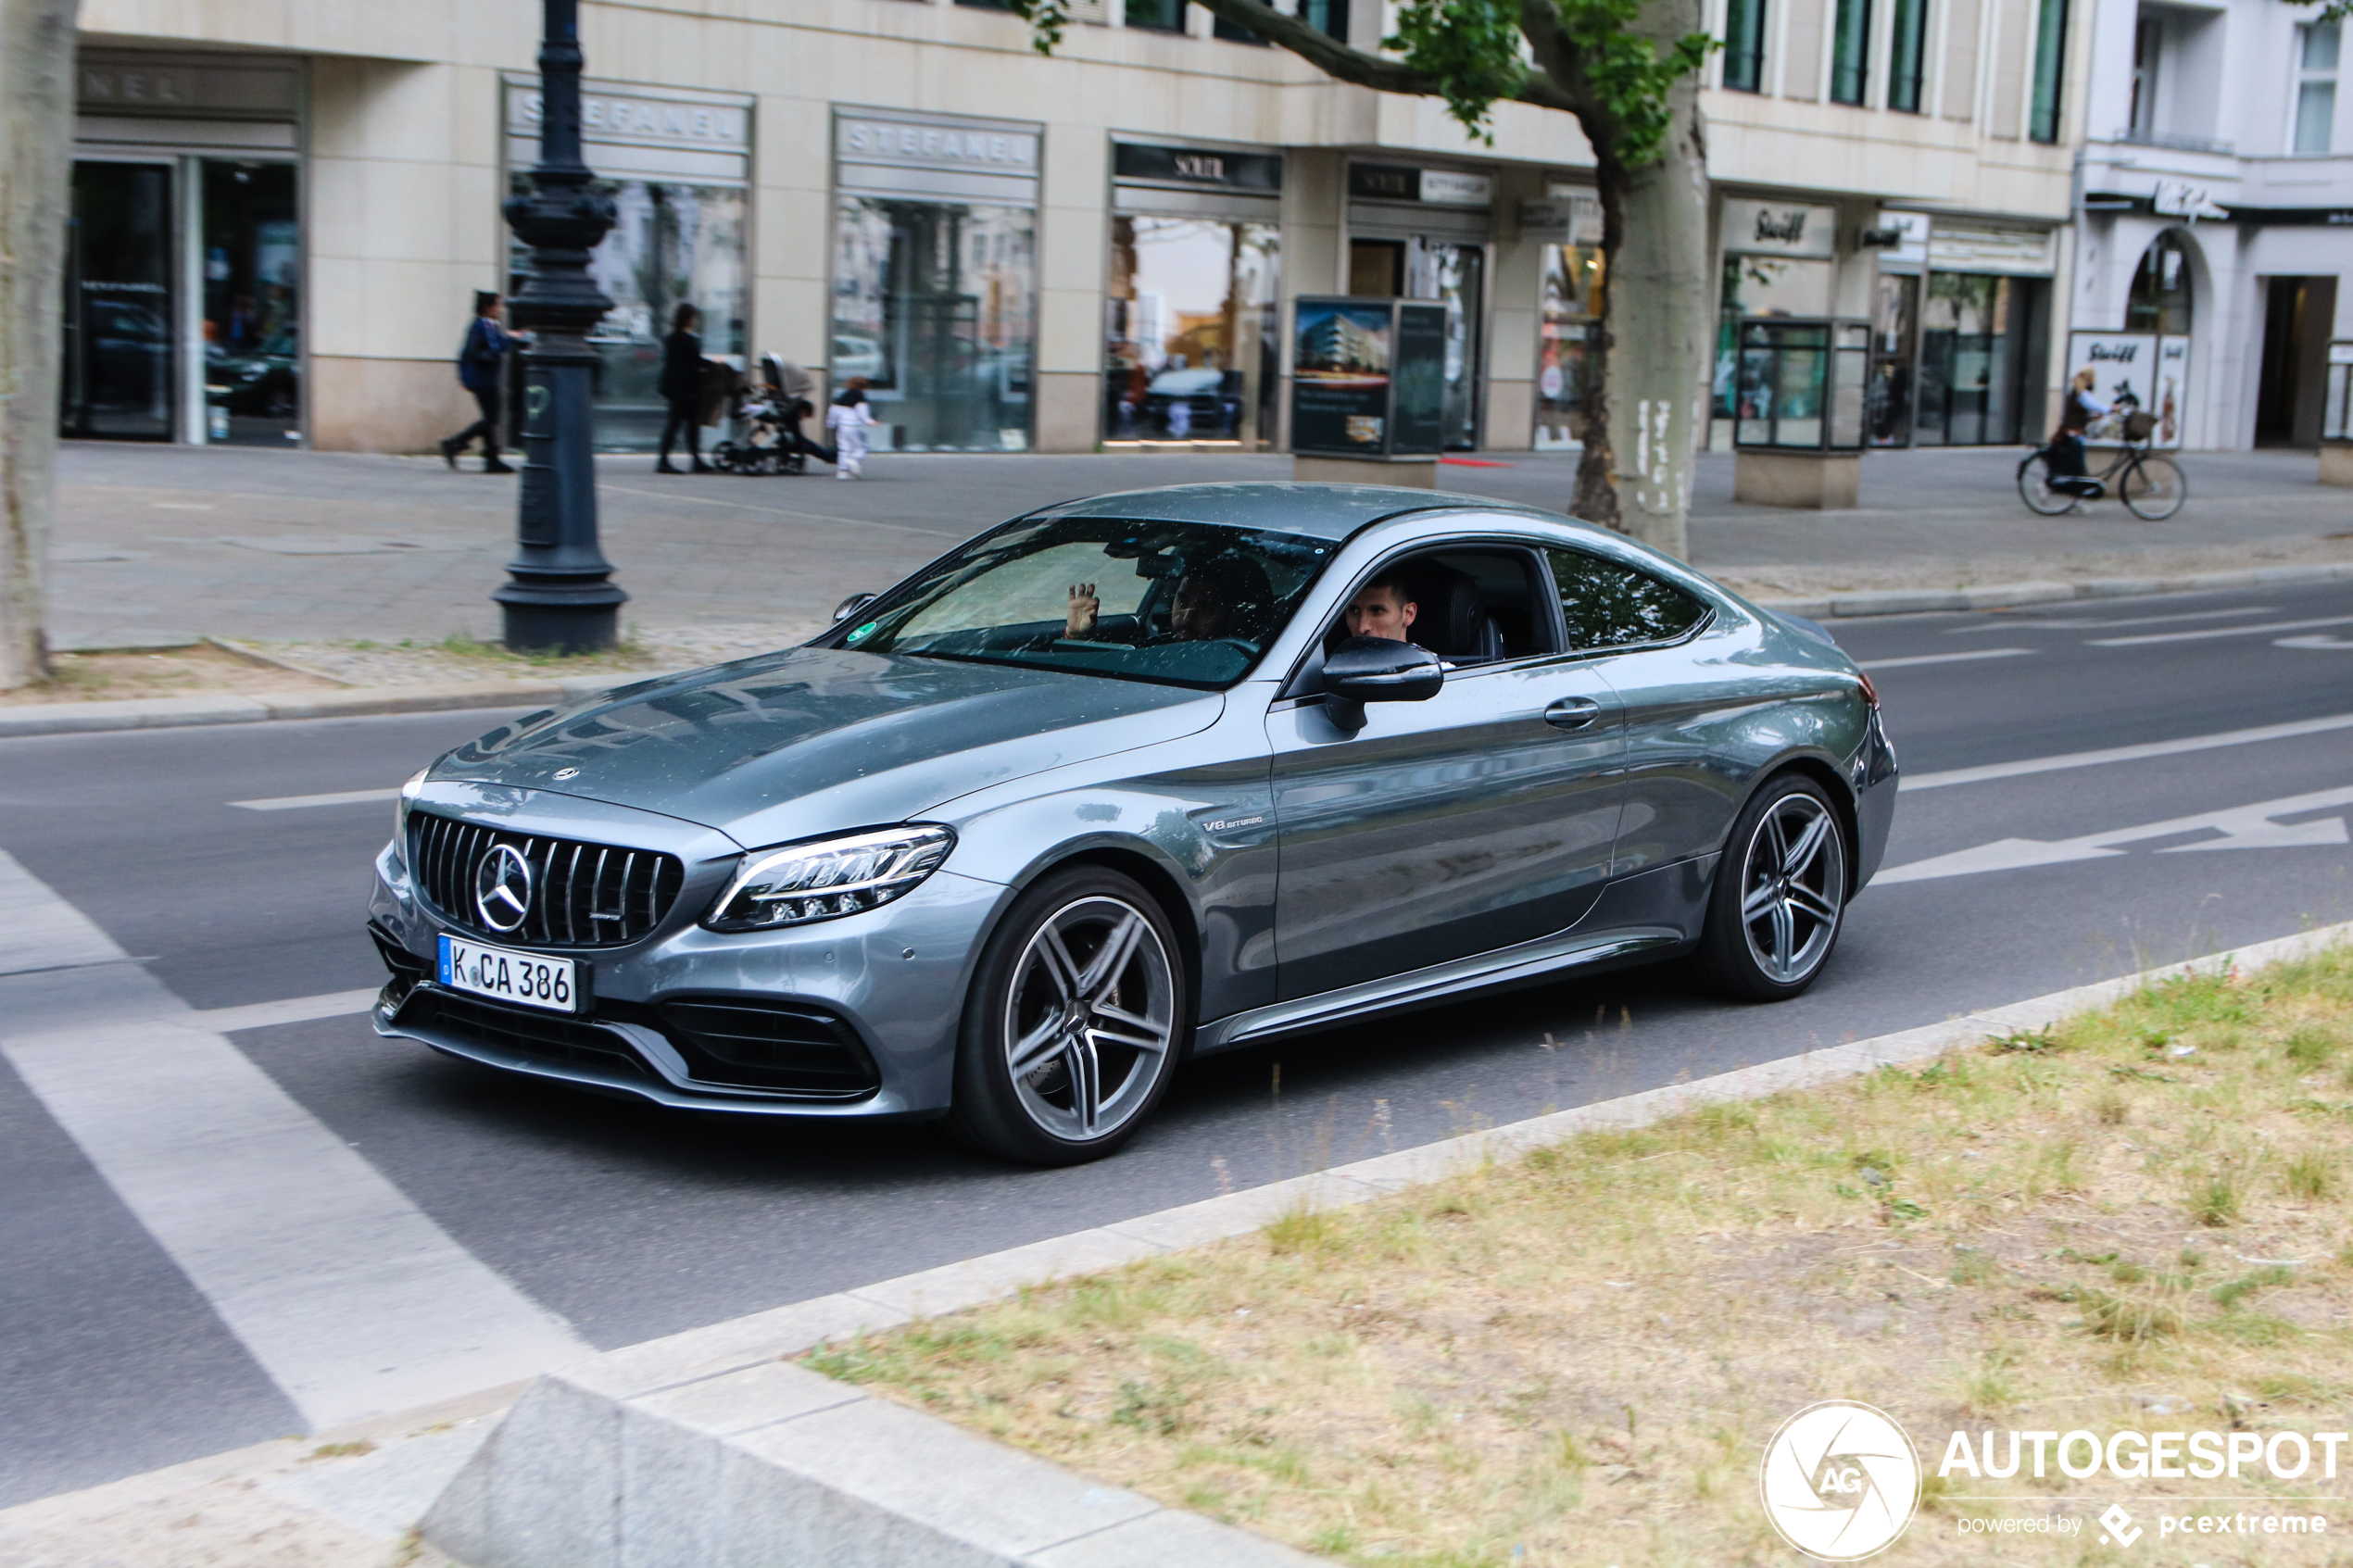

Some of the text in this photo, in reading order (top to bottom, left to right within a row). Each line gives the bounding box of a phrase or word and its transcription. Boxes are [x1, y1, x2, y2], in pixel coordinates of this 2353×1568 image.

[522, 94, 734, 138] SEFANEL
[849, 124, 1027, 163] STEFANEL
[1755, 208, 1806, 244] Steiff
[2088, 342, 2138, 363] Steiff
[1202, 816, 1263, 833] V8 BITURBO
[453, 946, 570, 1003] K CA 386
